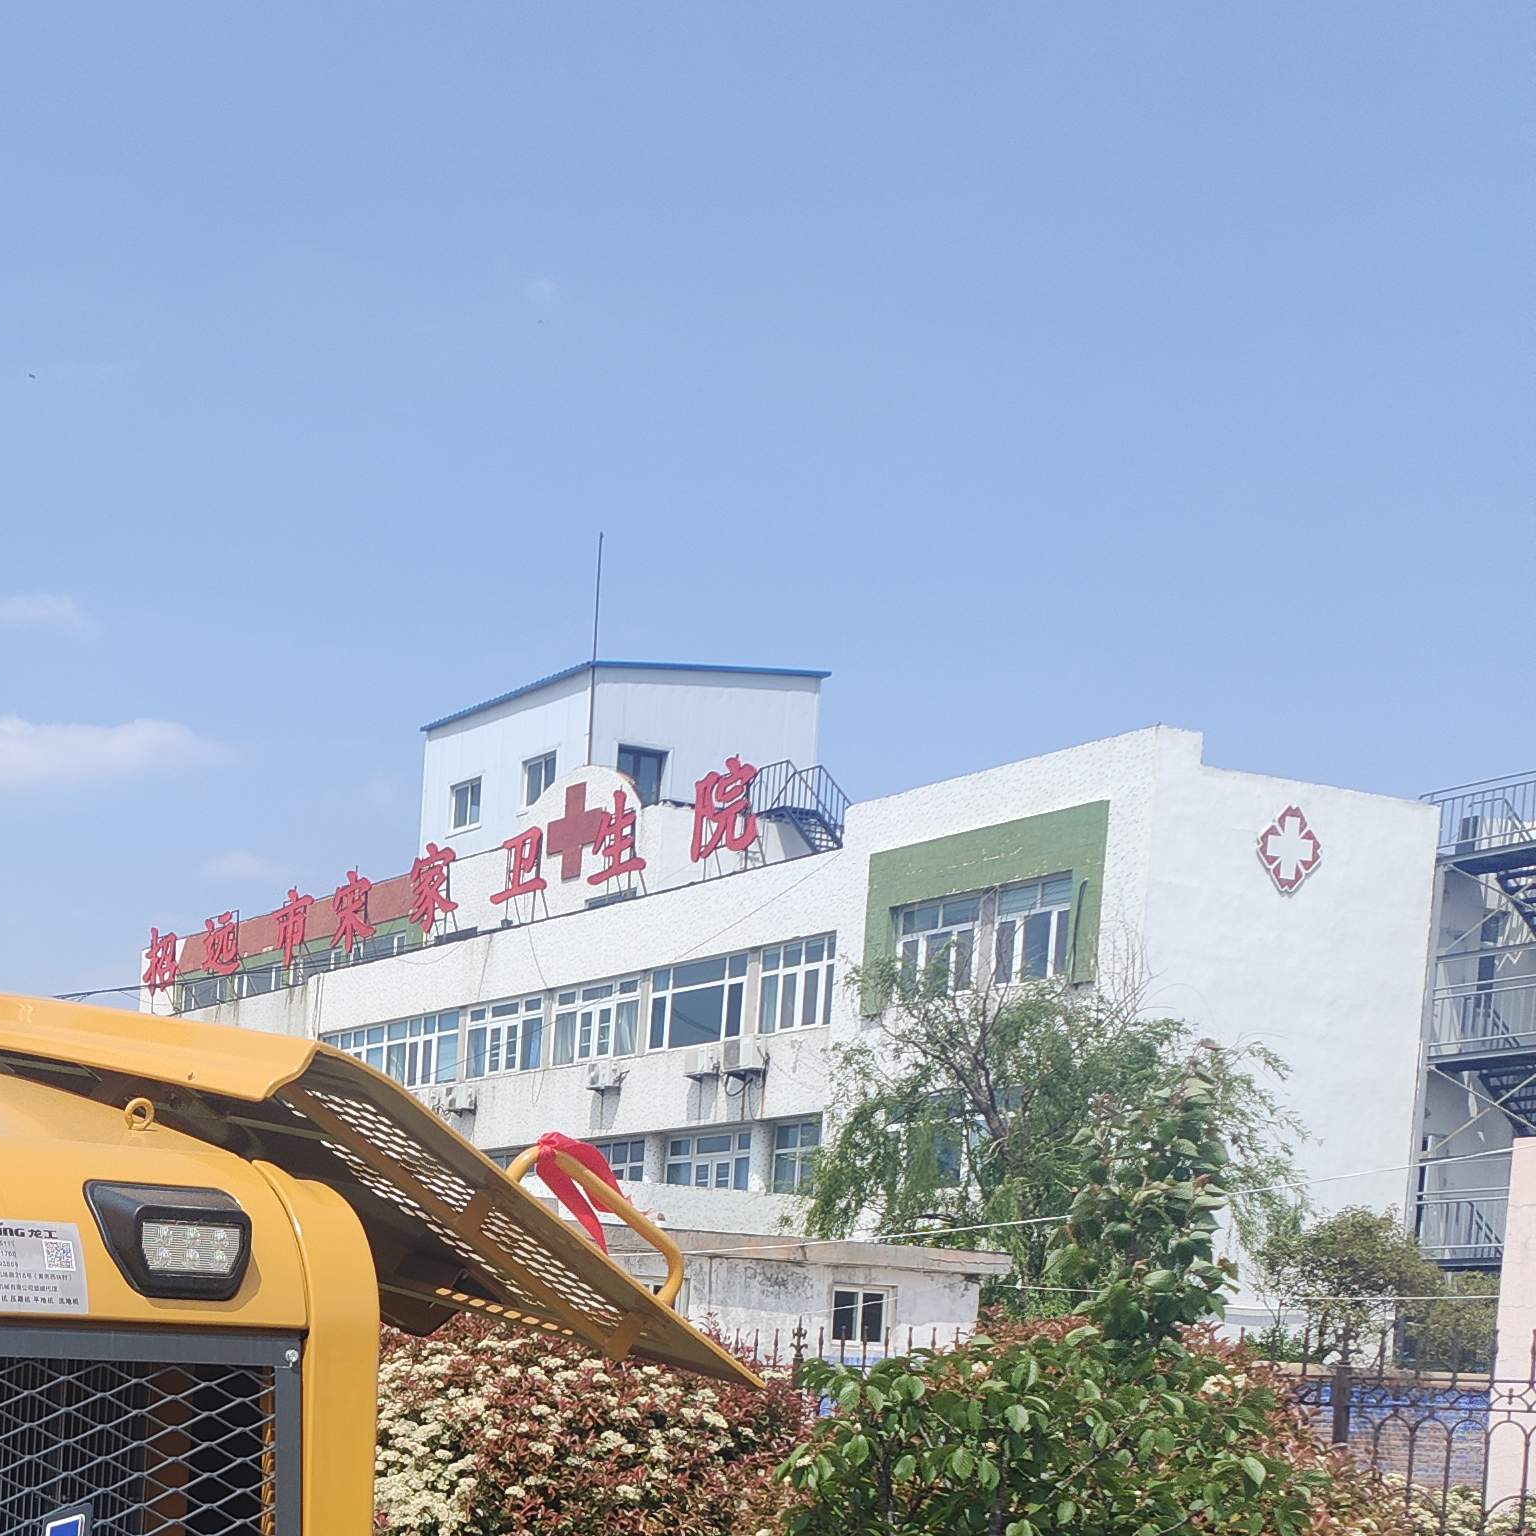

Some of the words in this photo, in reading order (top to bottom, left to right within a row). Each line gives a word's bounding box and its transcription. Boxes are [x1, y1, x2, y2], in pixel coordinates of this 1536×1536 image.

[142, 754, 760, 996] 招远市宋家卫生院
[28, 1228, 59, 1240] 龙工
